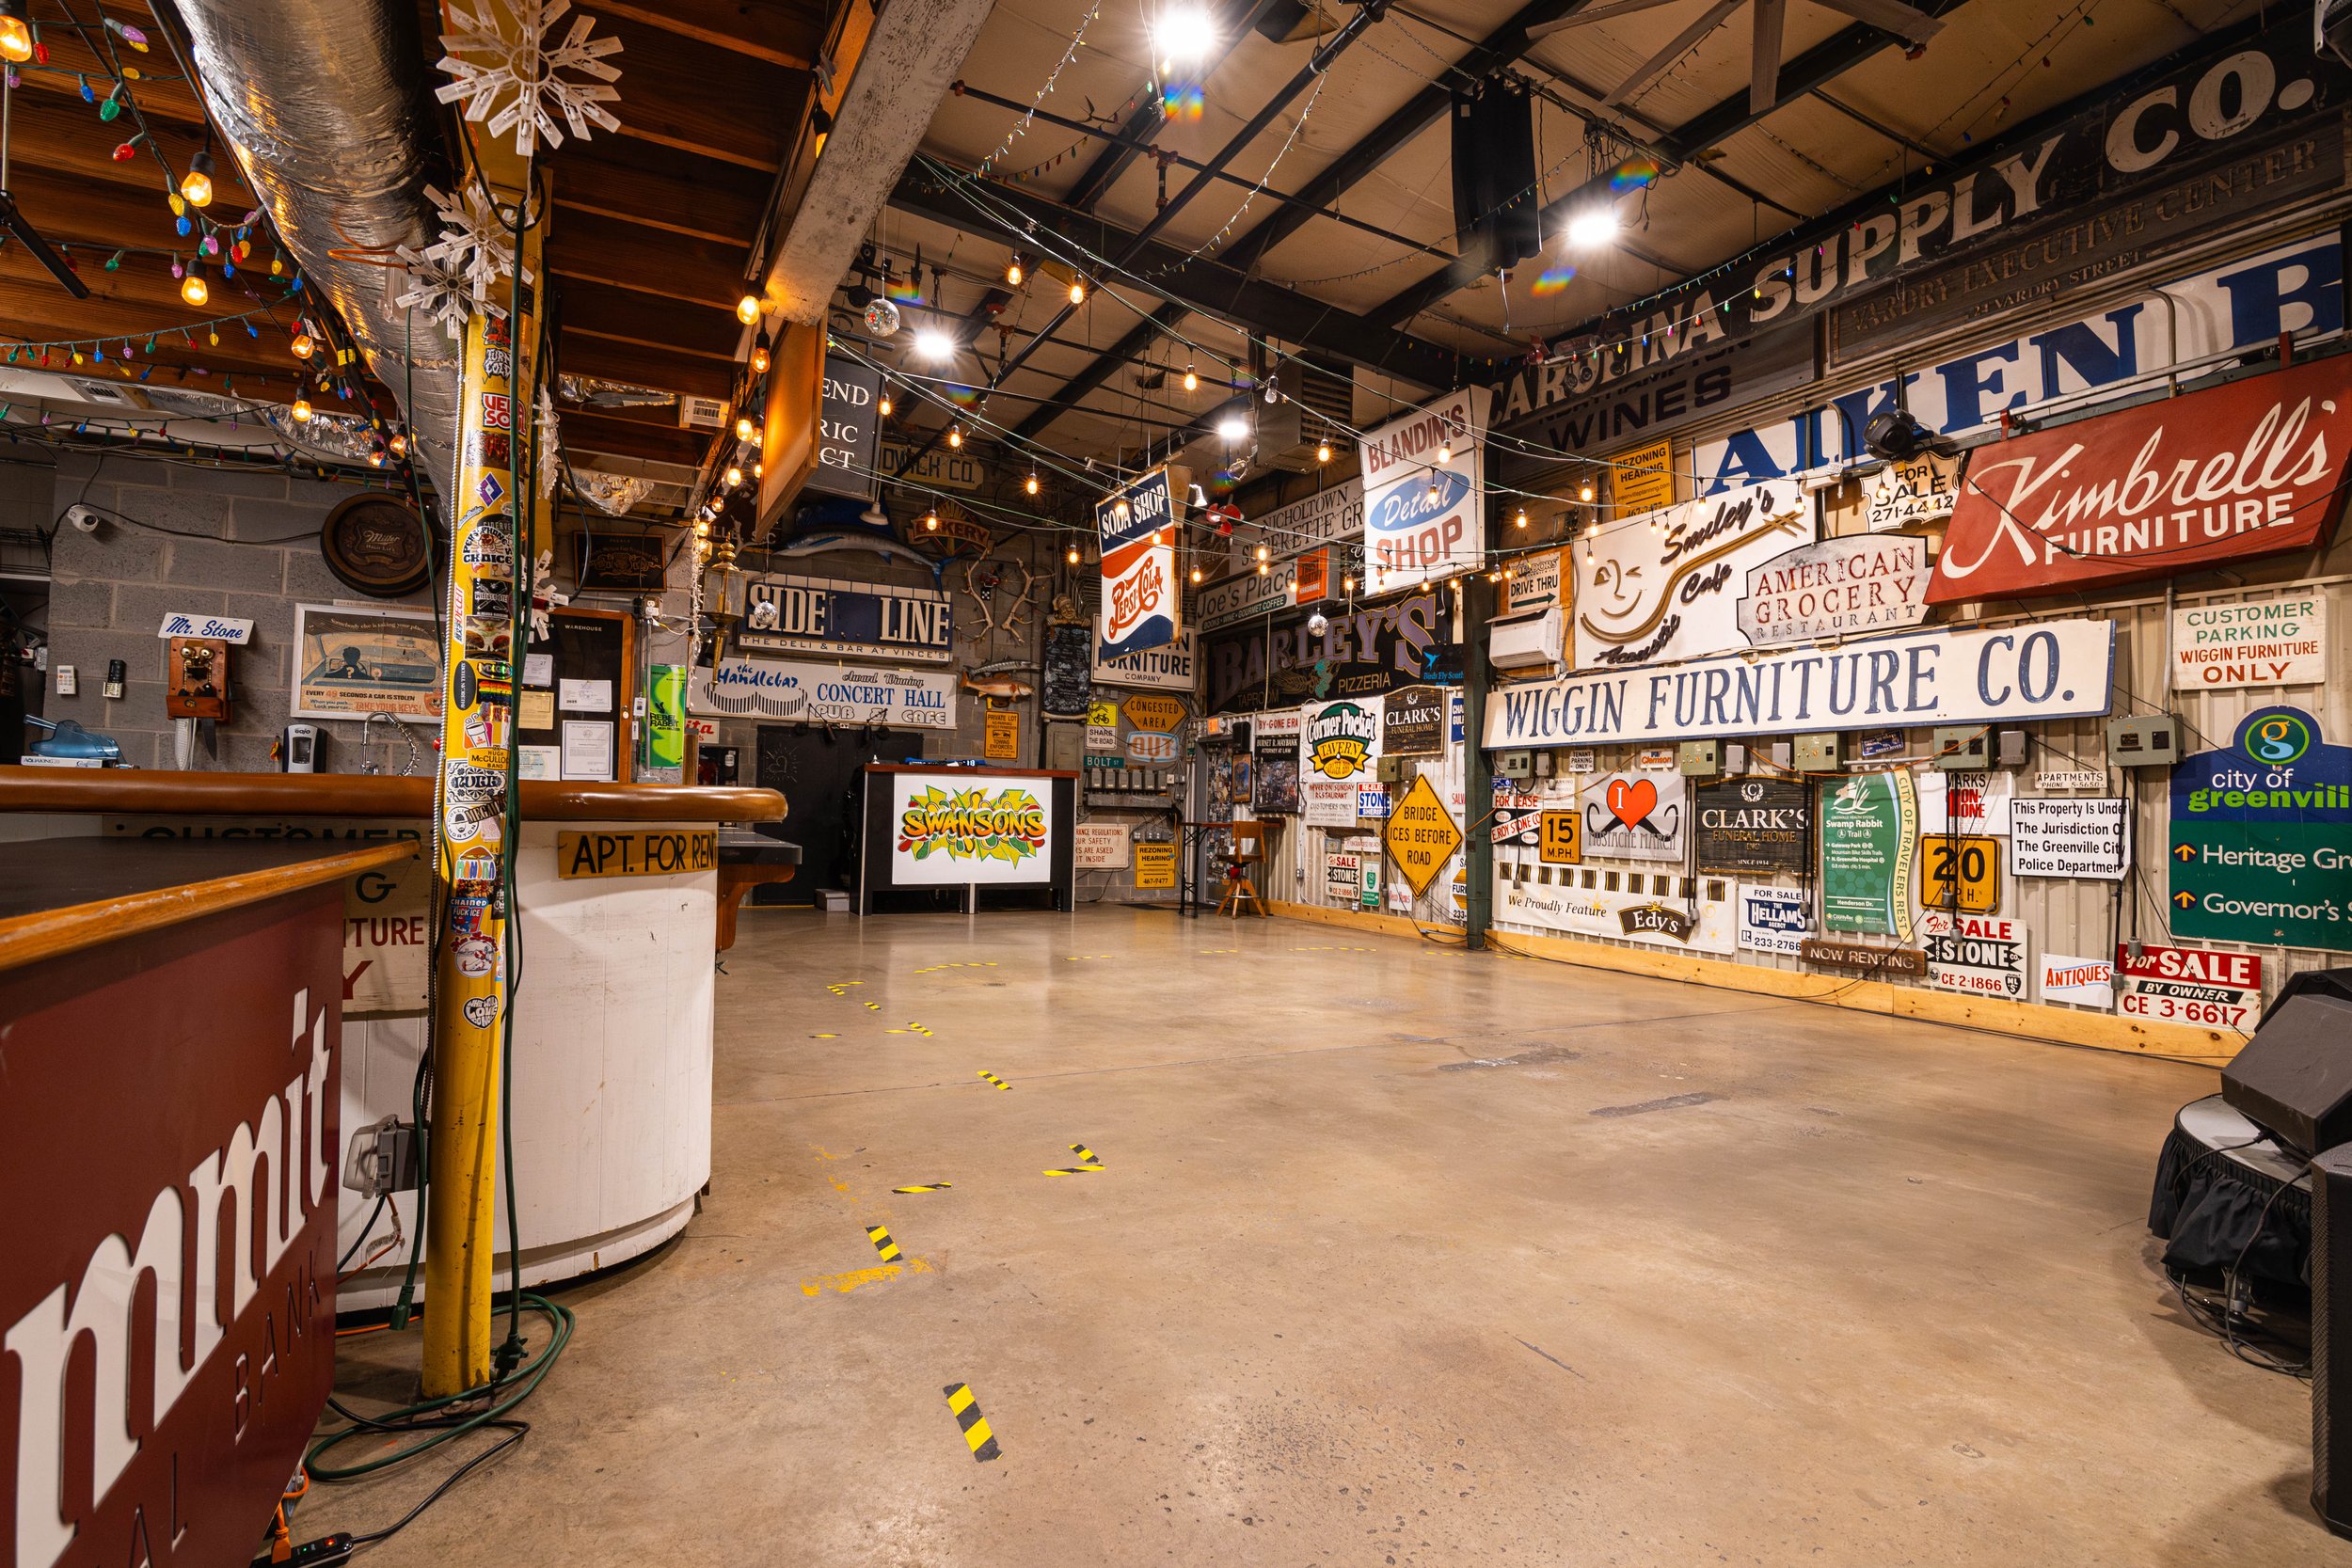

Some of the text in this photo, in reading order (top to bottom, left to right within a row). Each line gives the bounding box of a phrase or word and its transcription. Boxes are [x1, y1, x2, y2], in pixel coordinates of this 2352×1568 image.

[1750, 135, 2066, 324] SUPPLY
[2105, 50, 2314, 173] CO.
[1963, 139, 2316, 294] EXECUTIVE CENTER
[1994, 249, 2142, 312] VARDRY STREET
[1549, 365, 1731, 453] WINES
[1368, 404, 1467, 474] BLANDIN'S
[1615, 447, 1667, 470] REZONING
[1619, 462, 1664, 483] HEARING
[1894, 465, 1929, 484] FOR
[1383, 478, 1452, 527] Detail
[1874, 474, 1947, 509] SALE
[1102, 483, 1166, 540] SODA SHOP
[1263, 486, 1349, 530] NICHOLTOWN
[1661, 486, 1774, 564] Smiley's
[2045, 491, 2296, 565] FURNITURE
[1376, 515, 1463, 579] SHOP
[1755, 545, 1916, 597] AMERICAN
[1197, 585, 1240, 618] Joe's
[1246, 562, 1295, 602] Place
[1510, 574, 1558, 597] DRIVE THRU
[1263, 596, 1284, 610] COFFEE
[1756, 575, 1916, 626] GROCERY
[748, 583, 950, 646] SIDE LINE
[1756, 605, 1917, 639] RESTAURANT
[2186, 601, 2313, 627] CUSTOMER
[166, 615, 244, 640] Mr. Stone
[564, 624, 603, 632] WAREHOUSE
[2196, 622, 2300, 643] PARKING
[742, 637, 771, 646] THE
[780, 640, 812, 649] DELI
[836, 644, 863, 653] BAR
[893, 649, 946, 659] VINCE'S
[1213, 593, 1437, 707] BARLEY'S
[2180, 641, 2319, 664] WIGGIN FURNITURE
[717, 666, 799, 689] Handlebar
[1124, 673, 1162, 683] COMPANY
[1338, 671, 1391, 694] PIZZERIA
[2202, 661, 2293, 684] ONLY
[817, 683, 946, 708] CONCERT HALL
[1505, 631, 2075, 740] WIGGIN FURNITURE CO.
[815, 705, 946, 725] PUB CAFE
[1131, 700, 1179, 715] CONGESTED
[1386, 706, 1441, 726] CLARK'S
[1089, 728, 1113, 736] SHARE
[1142, 717, 1167, 728] AREA
[1308, 708, 1375, 743] Corner Pocket
[1416, 722, 1434, 733] HOME
[1320, 741, 1360, 758] TAVERN
[1641, 755, 1672, 764] Clemson
[2037, 772, 2104, 782] APARTMENTS
[2212, 768, 2295, 792] city of
[1359, 792, 1391, 807] STONE
[1495, 795, 1510, 808] FOR
[1513, 795, 1538, 808] LEASE
[2013, 802, 2095, 817] This Property Is
[902, 809, 1047, 839] SWANSONS
[1404, 806, 1438, 821] BRIDGE
[1701, 808, 1809, 830] CLARK'S
[1826, 819, 1883, 829] Swamp Rabbit
[1091, 828, 1123, 836] REGULATIONS
[1390, 827, 1452, 845] ICES BEFORE
[1548, 817, 1574, 844] 15
[1712, 830, 1797, 843] FUNERAL HOME
[1847, 830, 1862, 838] Trail
[2016, 821, 2108, 835] The Jurisdiction
[1588, 830, 1676, 850] MUSTACHE MARCH
[2016, 840, 2100, 854] The Greenville
[571, 834, 687, 875] APT. FOR
[1336, 856, 1357, 867] SALE
[1406, 849, 1431, 866] ROAD
[1547, 847, 1574, 859] M.P.H.
[1895, 776, 1913, 930] CITY TRAVELERS REST
[2019, 858, 2054, 871] Police
[2202, 844, 2306, 874] Heritage
[1333, 869, 1355, 882] STONE
[1932, 847, 1986, 883] 20
[1754, 889, 1802, 900] FOR SALE
[1508, 895, 1607, 918] We Proudly Feature
[1751, 903, 1806, 929] HELLAMS
[2202, 893, 2340, 922] Governor's
[1632, 911, 1680, 932] Edy's
[1926, 915, 2012, 940] For SALE
[1754, 937, 1802, 951] 233-2766
[1941, 939, 2010, 968] STONE
[1809, 945, 1915, 970] NOW RENTING
[2159, 950, 2250, 985] SALE
[1941, 973, 1955, 986] CE
[2045, 965, 2111, 988] ANTIQUES
[2144, 982, 2230, 1003] BY OWNER
[2122, 994, 2248, 1026] CE 3-6617
[235, 1236, 322, 1446] BANK
